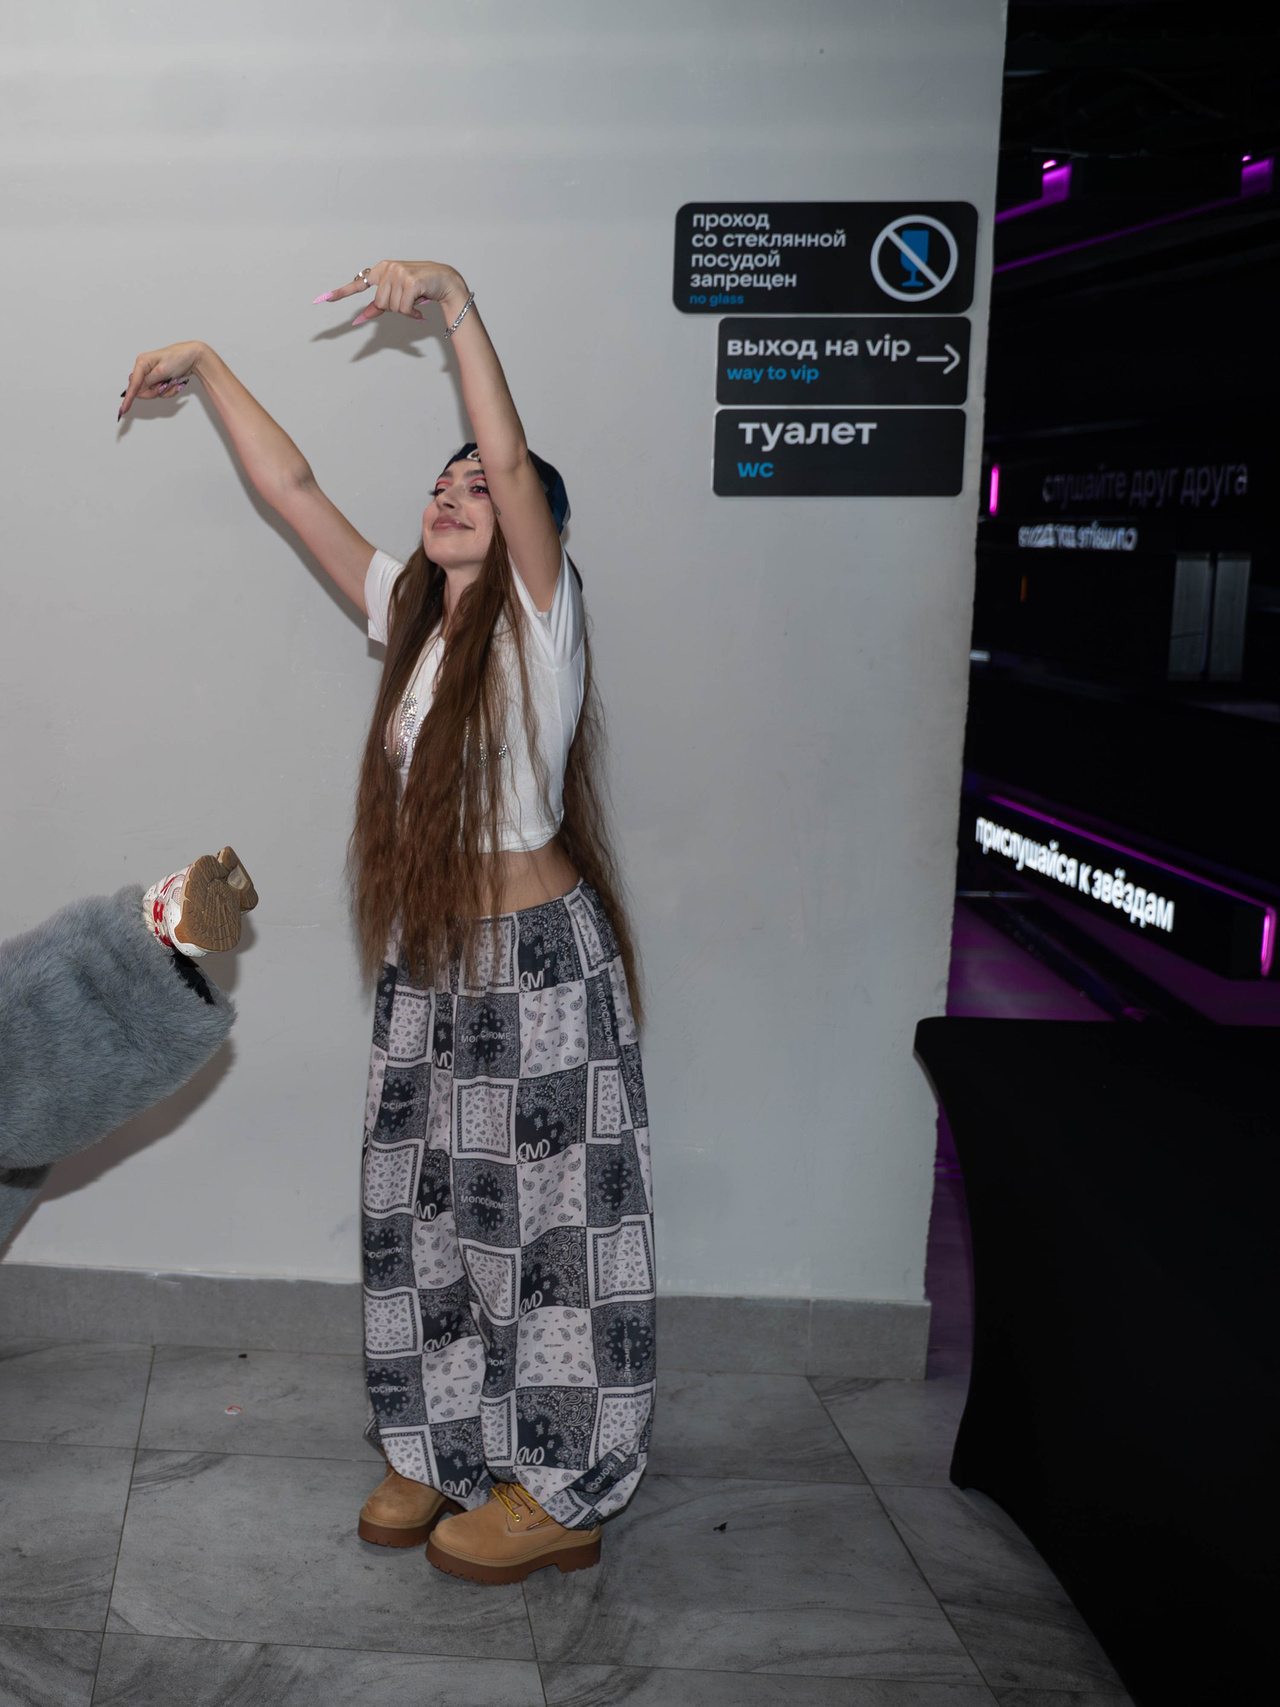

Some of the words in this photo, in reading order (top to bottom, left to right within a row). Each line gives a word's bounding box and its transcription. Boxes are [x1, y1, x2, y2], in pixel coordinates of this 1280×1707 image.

[692, 213, 770, 231] проход
[691, 234, 717, 248] со
[722, 230, 846, 248] стеклянной
[691, 250, 781, 271] посудой
[690, 273, 797, 292] запрещен
[689, 295, 707, 305] no
[710, 293, 744, 307] glass
[726, 339, 818, 360] выход
[825, 339, 858, 357] на
[865, 333, 911, 362] vip
[727, 367, 764, 384] way
[767, 365, 787, 381] to
[790, 365, 820, 384] vip
[738, 422, 877, 452] туалет
[737, 461, 775, 478] wc
[1129, 468, 1180, 510] друг
[1180, 461, 1249, 509] друга
[975, 816, 1078, 887] прислушайся
[1078, 862, 1091, 894] к
[1091, 867, 1176, 933] звёздам
[461, 1029, 511, 1043] MOCHROME
